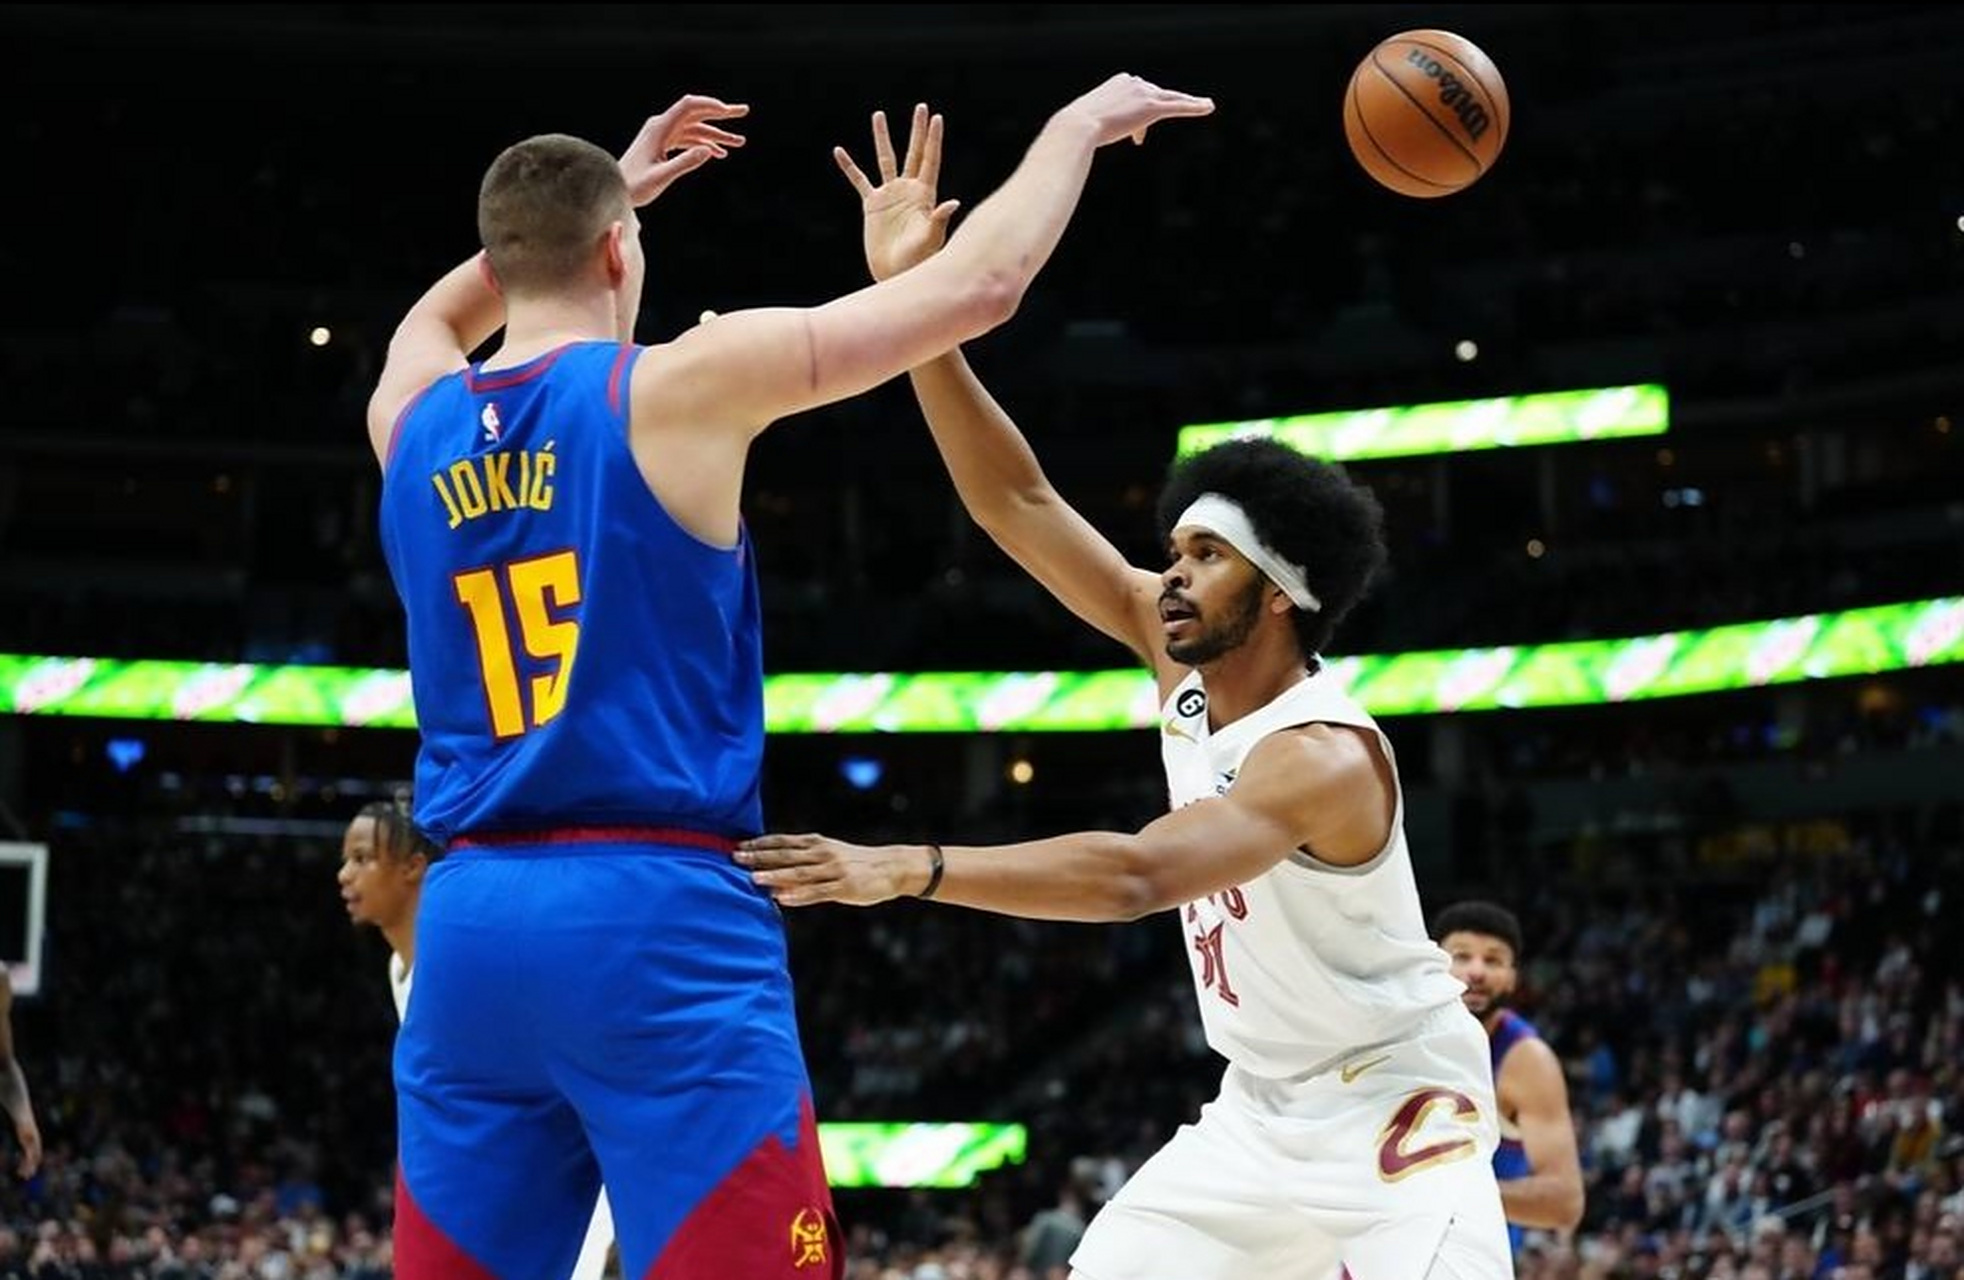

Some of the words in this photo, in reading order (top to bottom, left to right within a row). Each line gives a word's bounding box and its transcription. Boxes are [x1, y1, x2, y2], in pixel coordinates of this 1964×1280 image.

[1409, 49, 1489, 142] Wilson
[432, 440, 556, 529] JOKIĆ
[452, 549, 583, 742] 15
